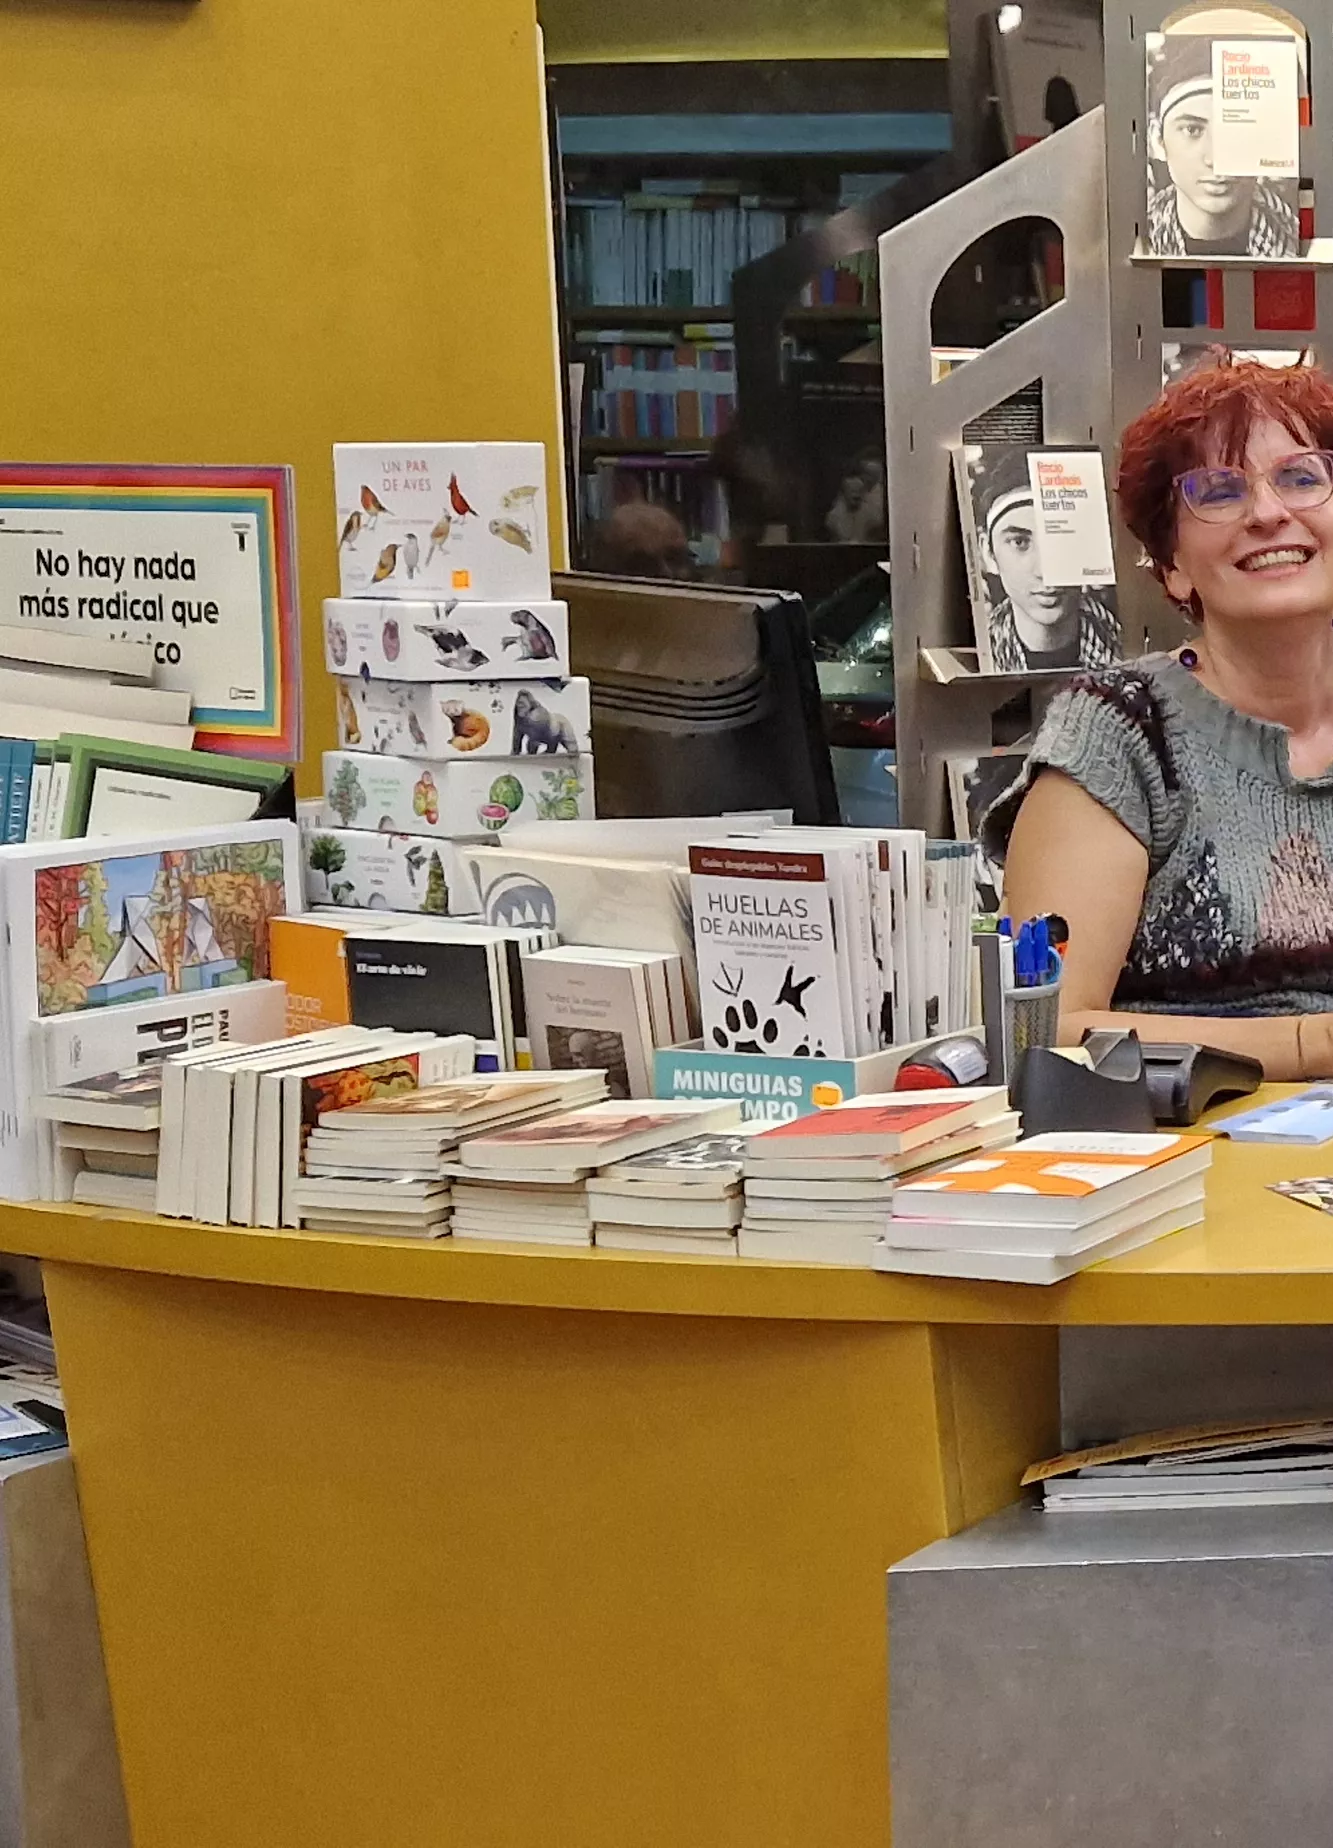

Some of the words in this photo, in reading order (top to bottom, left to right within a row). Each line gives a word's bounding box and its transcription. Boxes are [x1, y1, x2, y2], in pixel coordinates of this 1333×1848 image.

[382, 461, 400, 473] UN
[406, 460, 428, 473] PAR
[383, 478, 400, 492] DE
[404, 478, 431, 492] AVES
[36, 548, 70, 577] No
[78, 548, 125, 583] hay
[134, 551, 195, 581] nada
[19, 587, 69, 618] más
[78, 590, 163, 621] radical
[171, 600, 219, 628] que
[708, 892, 808, 918] HUELLAS
[700, 917, 723, 935] DE
[728, 920, 823, 941] ANIMALES
[673, 1069, 803, 1097] MINIGUIAS
